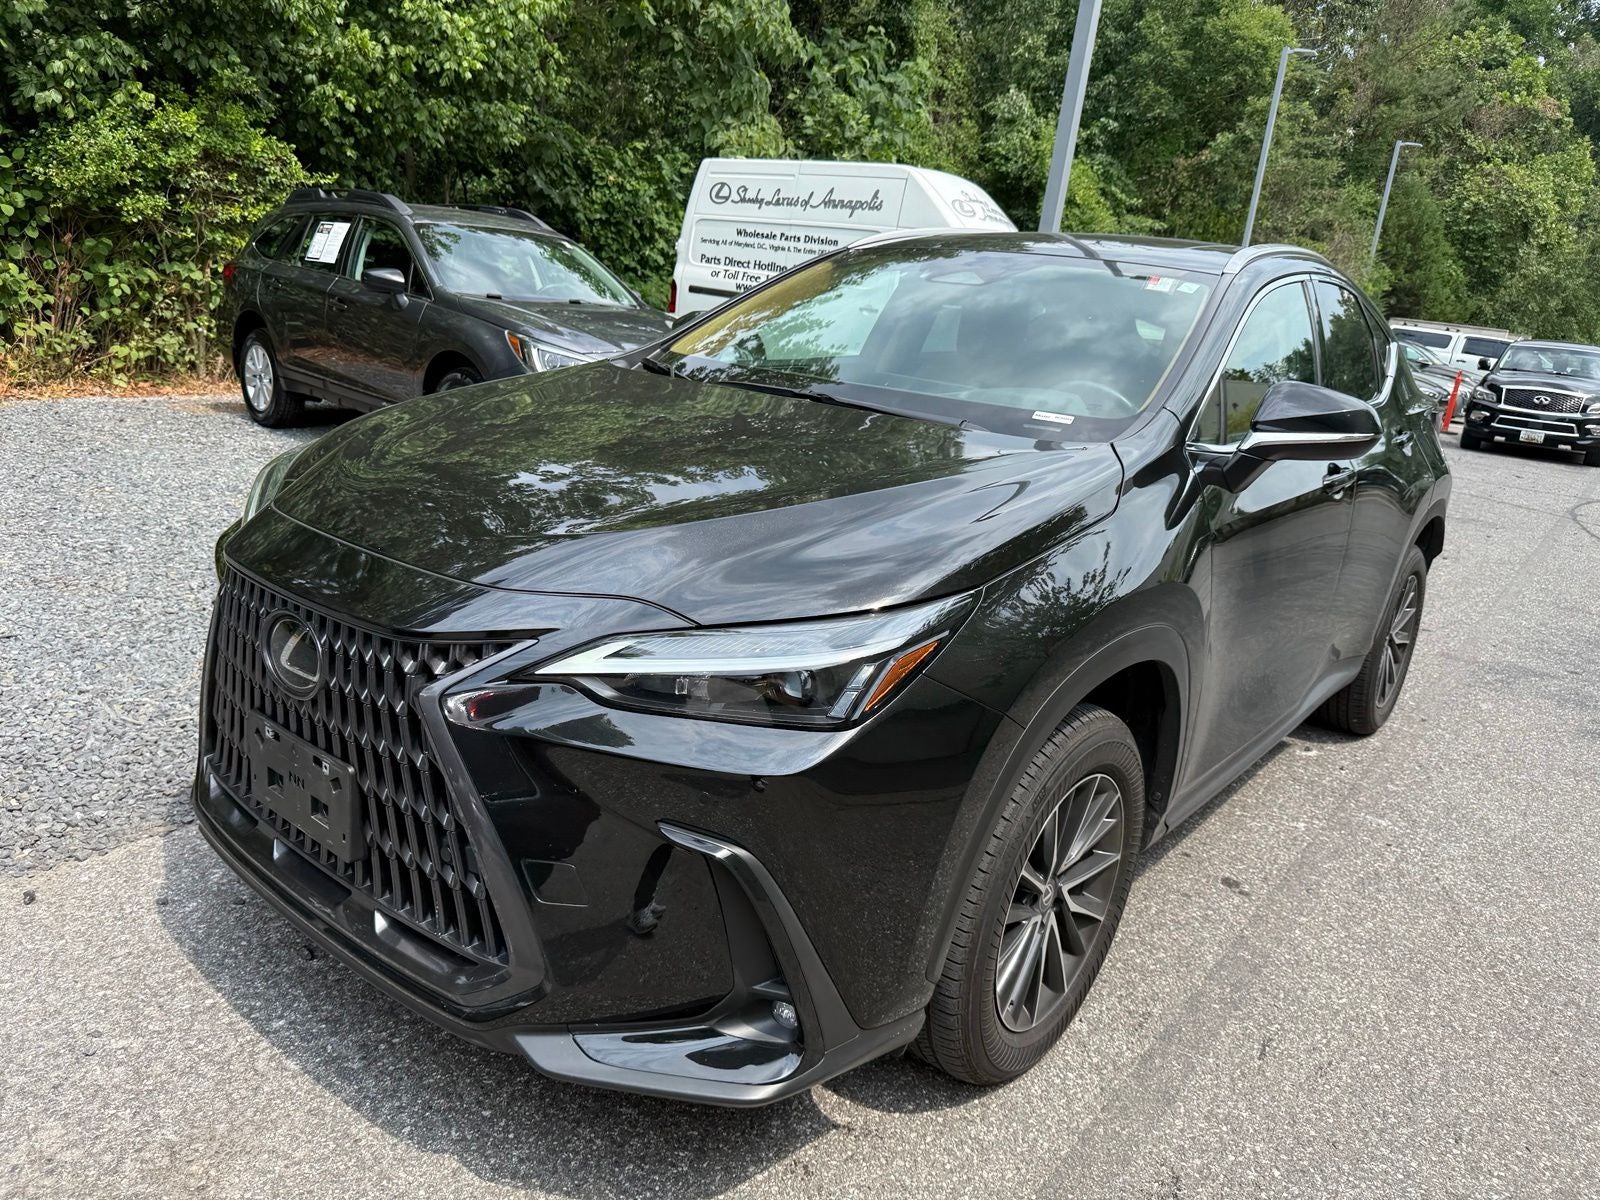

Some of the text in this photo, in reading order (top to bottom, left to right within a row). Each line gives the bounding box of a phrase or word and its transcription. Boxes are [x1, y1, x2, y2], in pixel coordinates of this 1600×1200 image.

[765, 188, 799, 207] Lexus
[800, 191, 814, 212] of
[811, 187, 883, 218] Annapolis
[700, 237, 720, 246] Servicing
[769, 244, 787, 252] Virginia
[803, 247, 817, 255] Entire
[736, 228, 839, 246] Wholesale Parts Division
[700, 254, 788, 273] Parts Direct Hotline
[711, 269, 721, 278] or
[723, 269, 739, 280] Toll
[741, 272, 761, 283] Free
